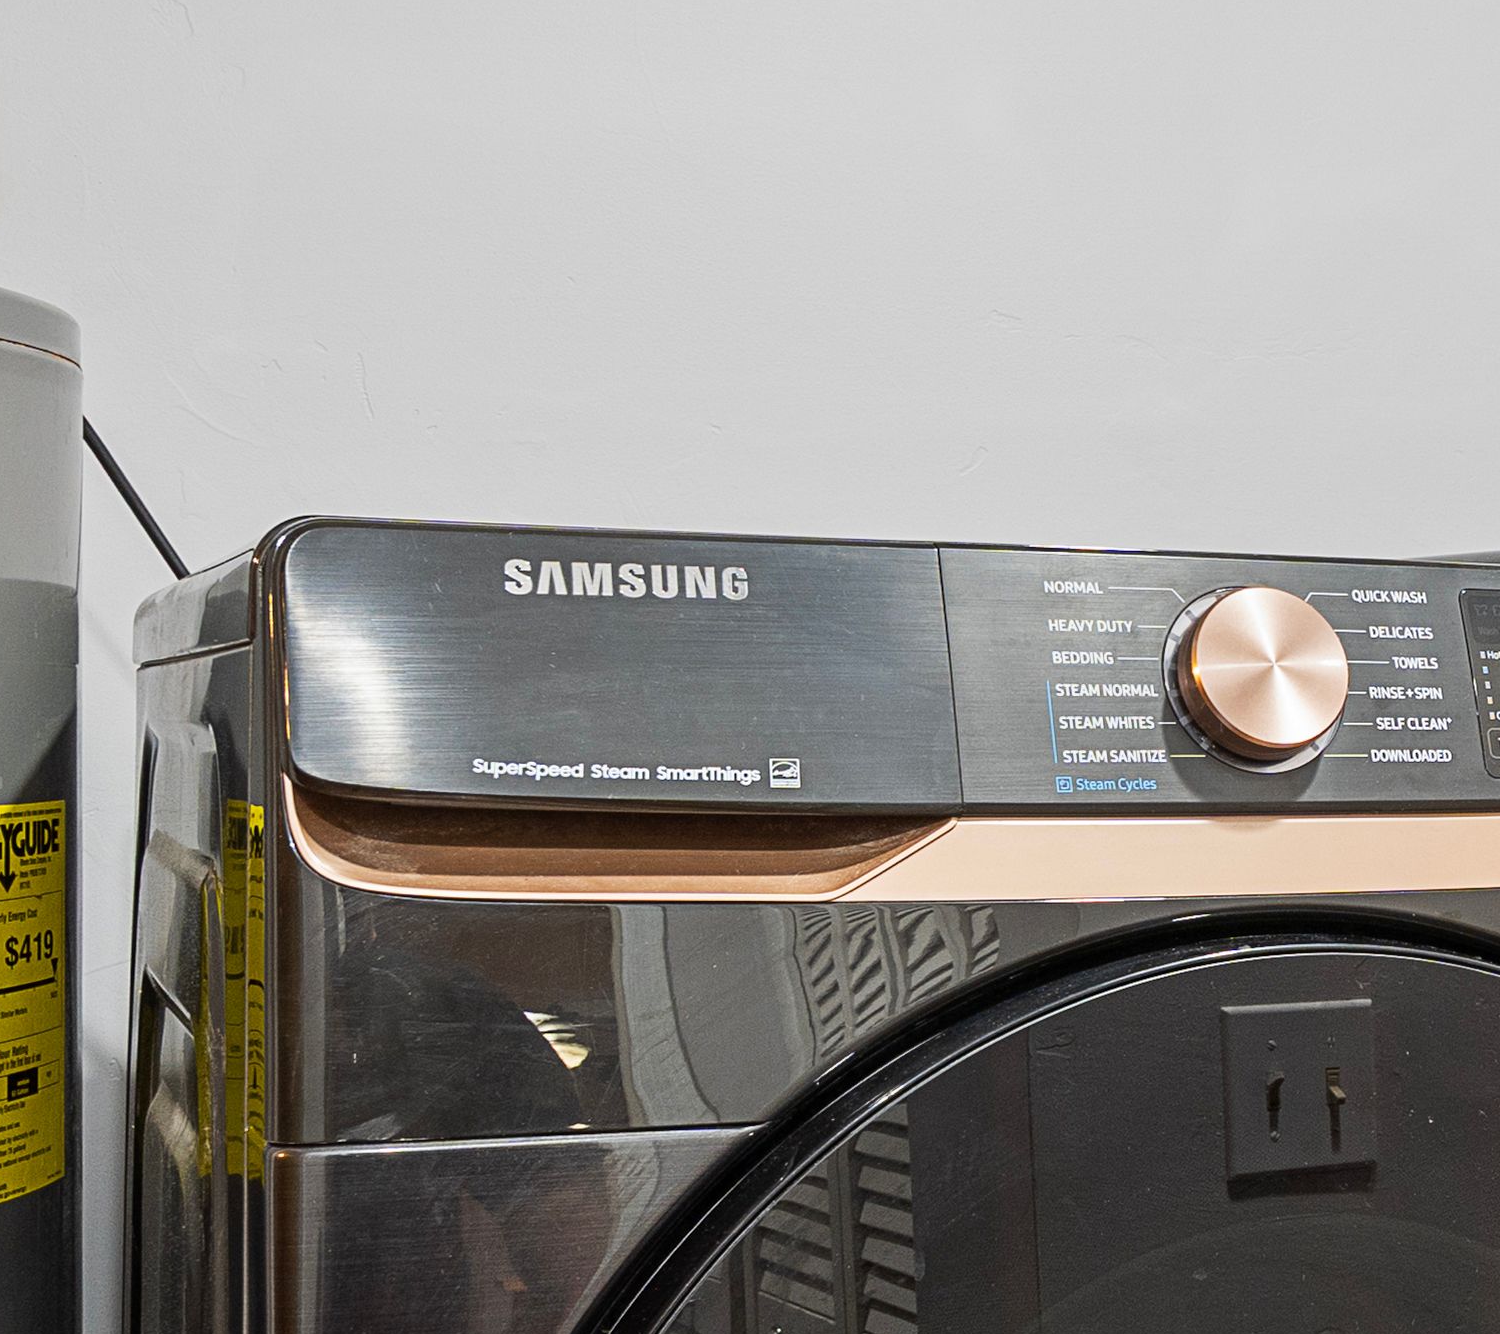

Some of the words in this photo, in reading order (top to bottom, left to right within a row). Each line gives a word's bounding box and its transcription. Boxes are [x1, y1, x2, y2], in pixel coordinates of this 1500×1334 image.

[504, 558, 749, 601] SAMSUNG
[1044, 581, 1103, 594] NORMAL
[1352, 589, 1388, 602] QUICK
[1390, 591, 1427, 604] WASH
[1048, 619, 1093, 632] HEAVY
[1097, 621, 1132, 633] DUTY
[1369, 626, 1433, 640] DELICATES
[1052, 651, 1114, 665] BEDDING
[1392, 657, 1438, 669] TOWELS
[1055, 684, 1100, 697] STEAM
[1102, 684, 1158, 697] NORMAL
[1059, 716, 1104, 729] STEAM
[1107, 716, 1155, 729] WHITES
[1376, 717, 1405, 730] SELF
[1063, 750, 1108, 763] STEAM
[1109, 750, 1167, 763] SANITIZE
[1371, 749, 1452, 762] DOWNLOADED
[472, 758, 585, 783] SuperSpeed
[590, 763, 650, 783] Steam
[656, 764, 761, 787] SmartThings
[1076, 777, 1116, 791] Steam
[1117, 778, 1157, 793] Cycles
[8, 910, 26, 924] Energy
[27, 908, 37, 918] Cost
[5, 929, 53, 969] $419
[12, 1045, 29, 1059] Rating
